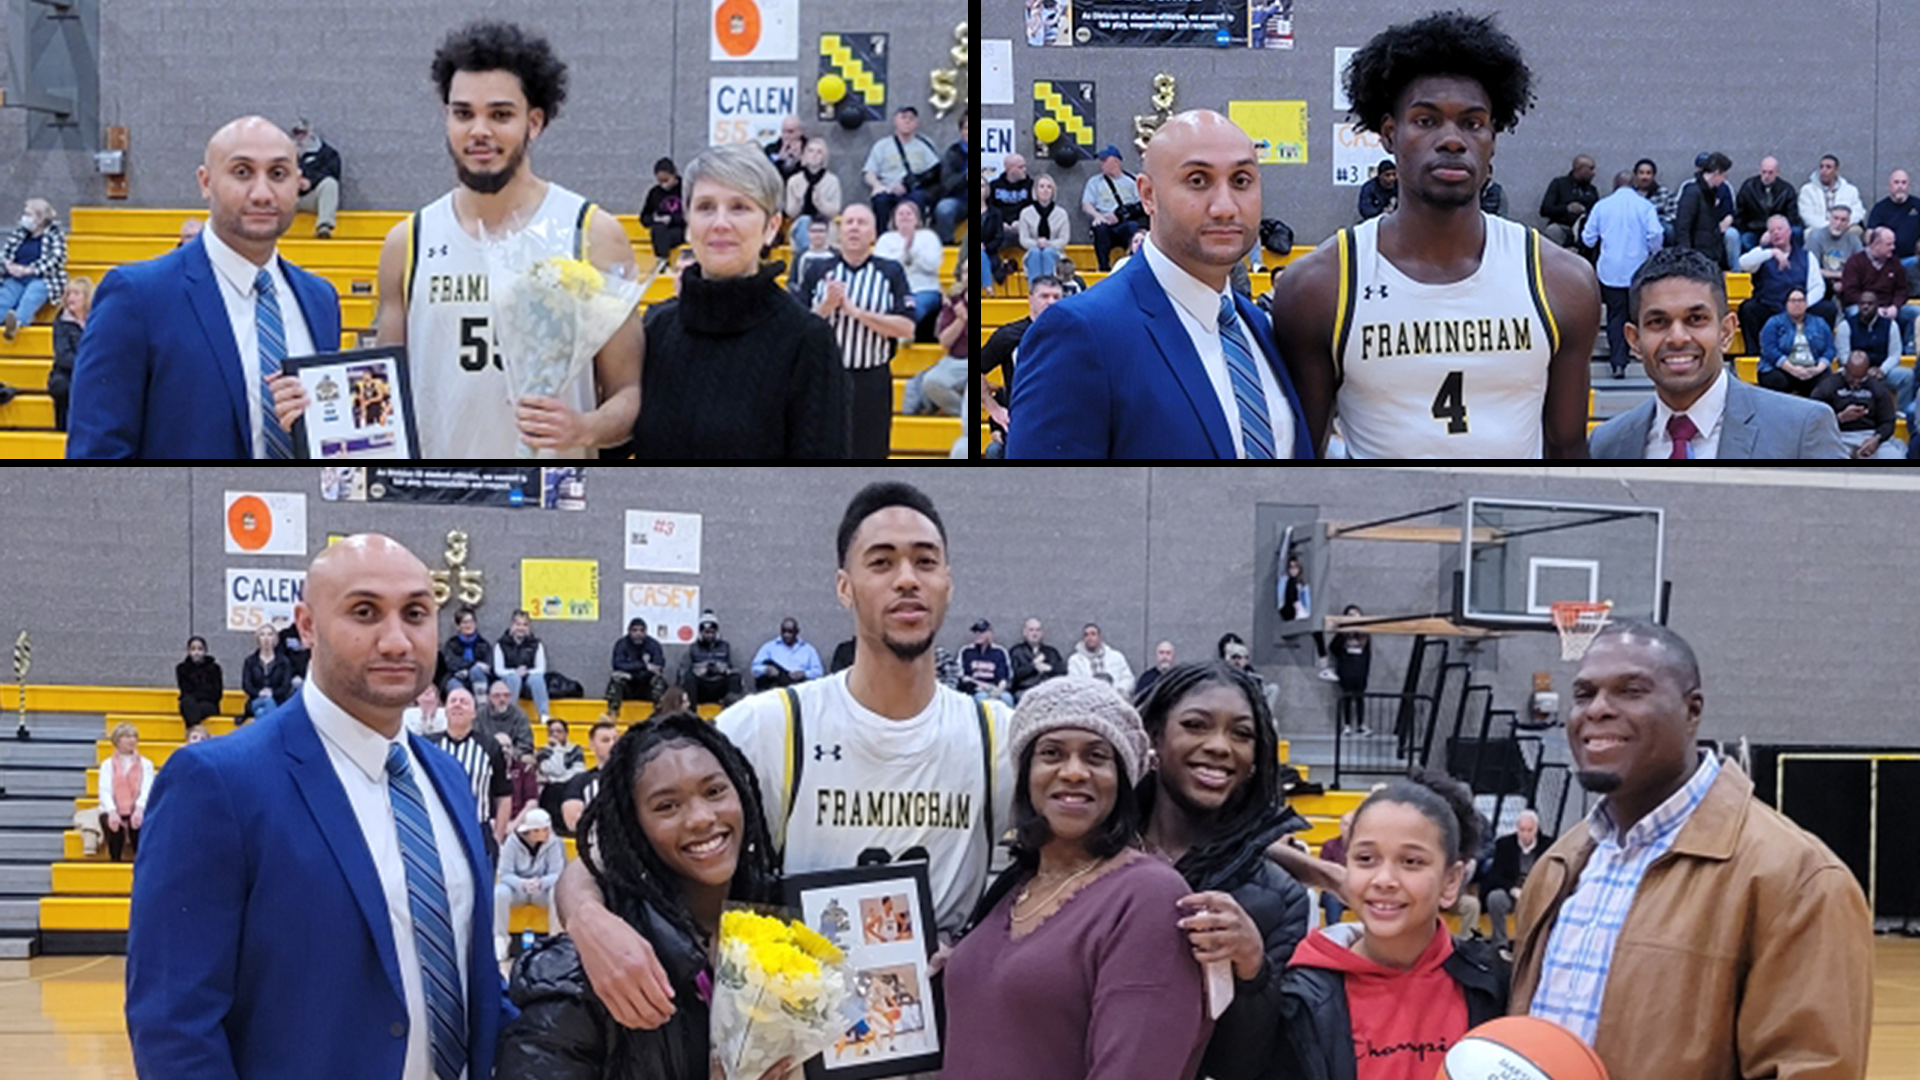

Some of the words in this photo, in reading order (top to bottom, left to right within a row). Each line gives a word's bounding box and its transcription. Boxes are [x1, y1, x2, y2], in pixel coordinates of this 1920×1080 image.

[717, 85, 794, 116] CALEN
[713, 120, 749, 144] 55
[1336, 165, 1359, 183] #3
[429, 273, 489, 304] FRAMI
[460, 317, 504, 372] 5
[1361, 316, 1532, 360] FRAMINGHAM
[1431, 370, 1468, 435] 4
[653, 519, 676, 538] #3
[232, 575, 304, 603] CALEN
[629, 585, 697, 608] CASEY
[230, 605, 263, 627] 55
[530, 599, 540, 616] 3
[816, 789, 970, 829] FRAMINGHAM
[1354, 1037, 1451, 1062] Champi
